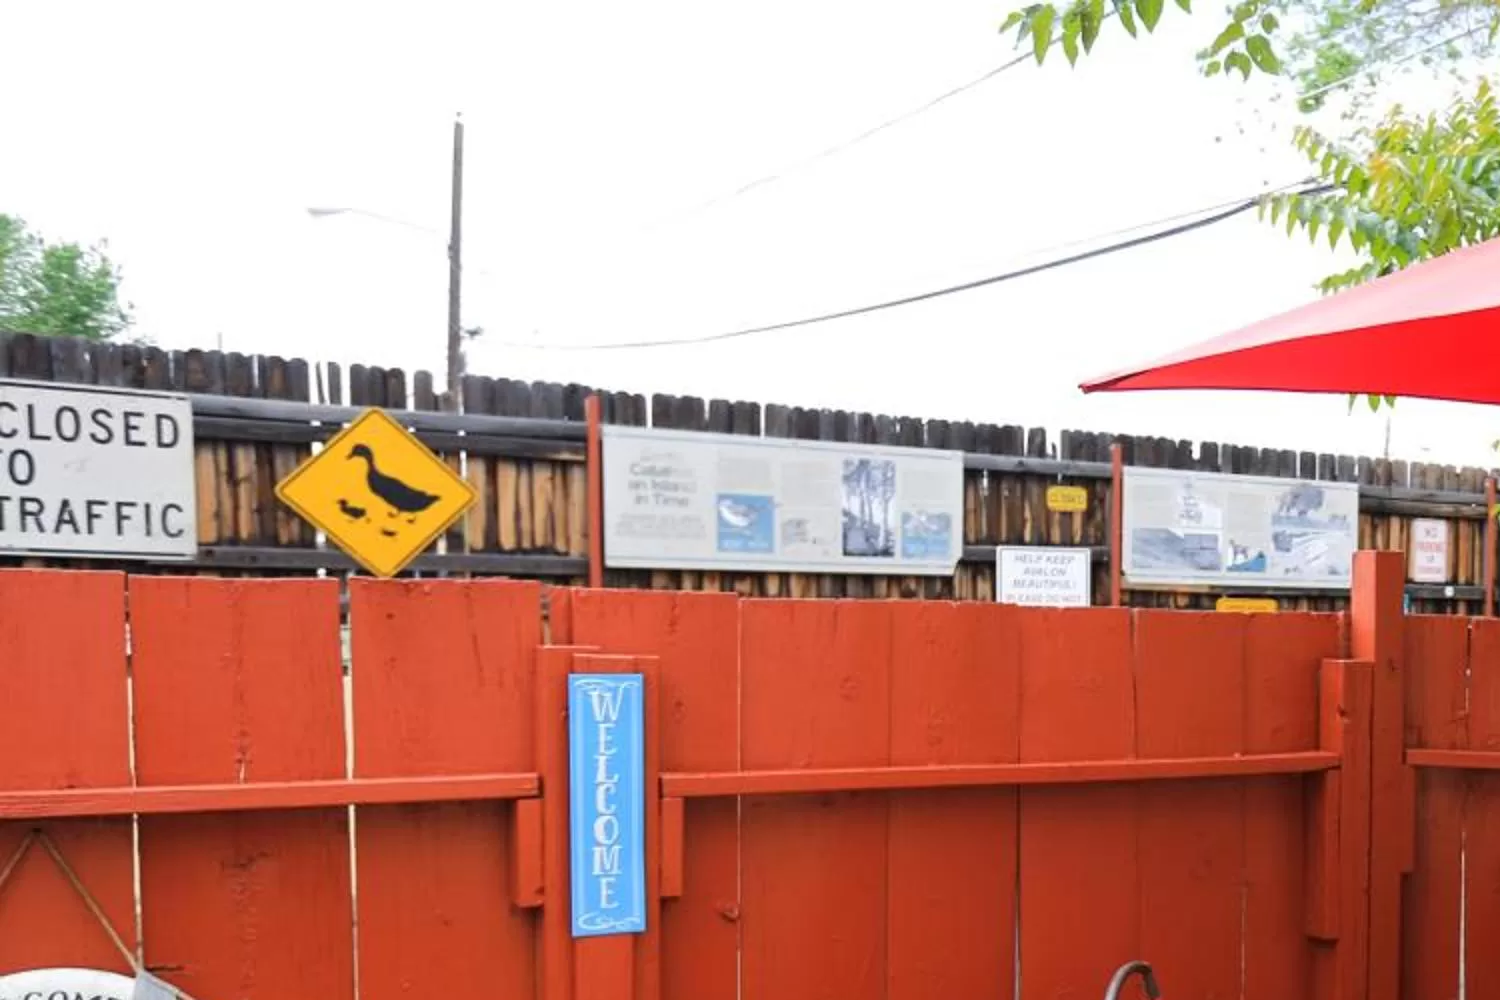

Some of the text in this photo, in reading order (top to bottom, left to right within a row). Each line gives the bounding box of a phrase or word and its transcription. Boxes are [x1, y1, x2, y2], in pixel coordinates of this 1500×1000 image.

[0, 401, 180, 448] CLOSED
[0, 448, 35, 486] O
[0, 495, 185, 539] TRAFFIC
[580, 679, 634, 912] WELCOME
